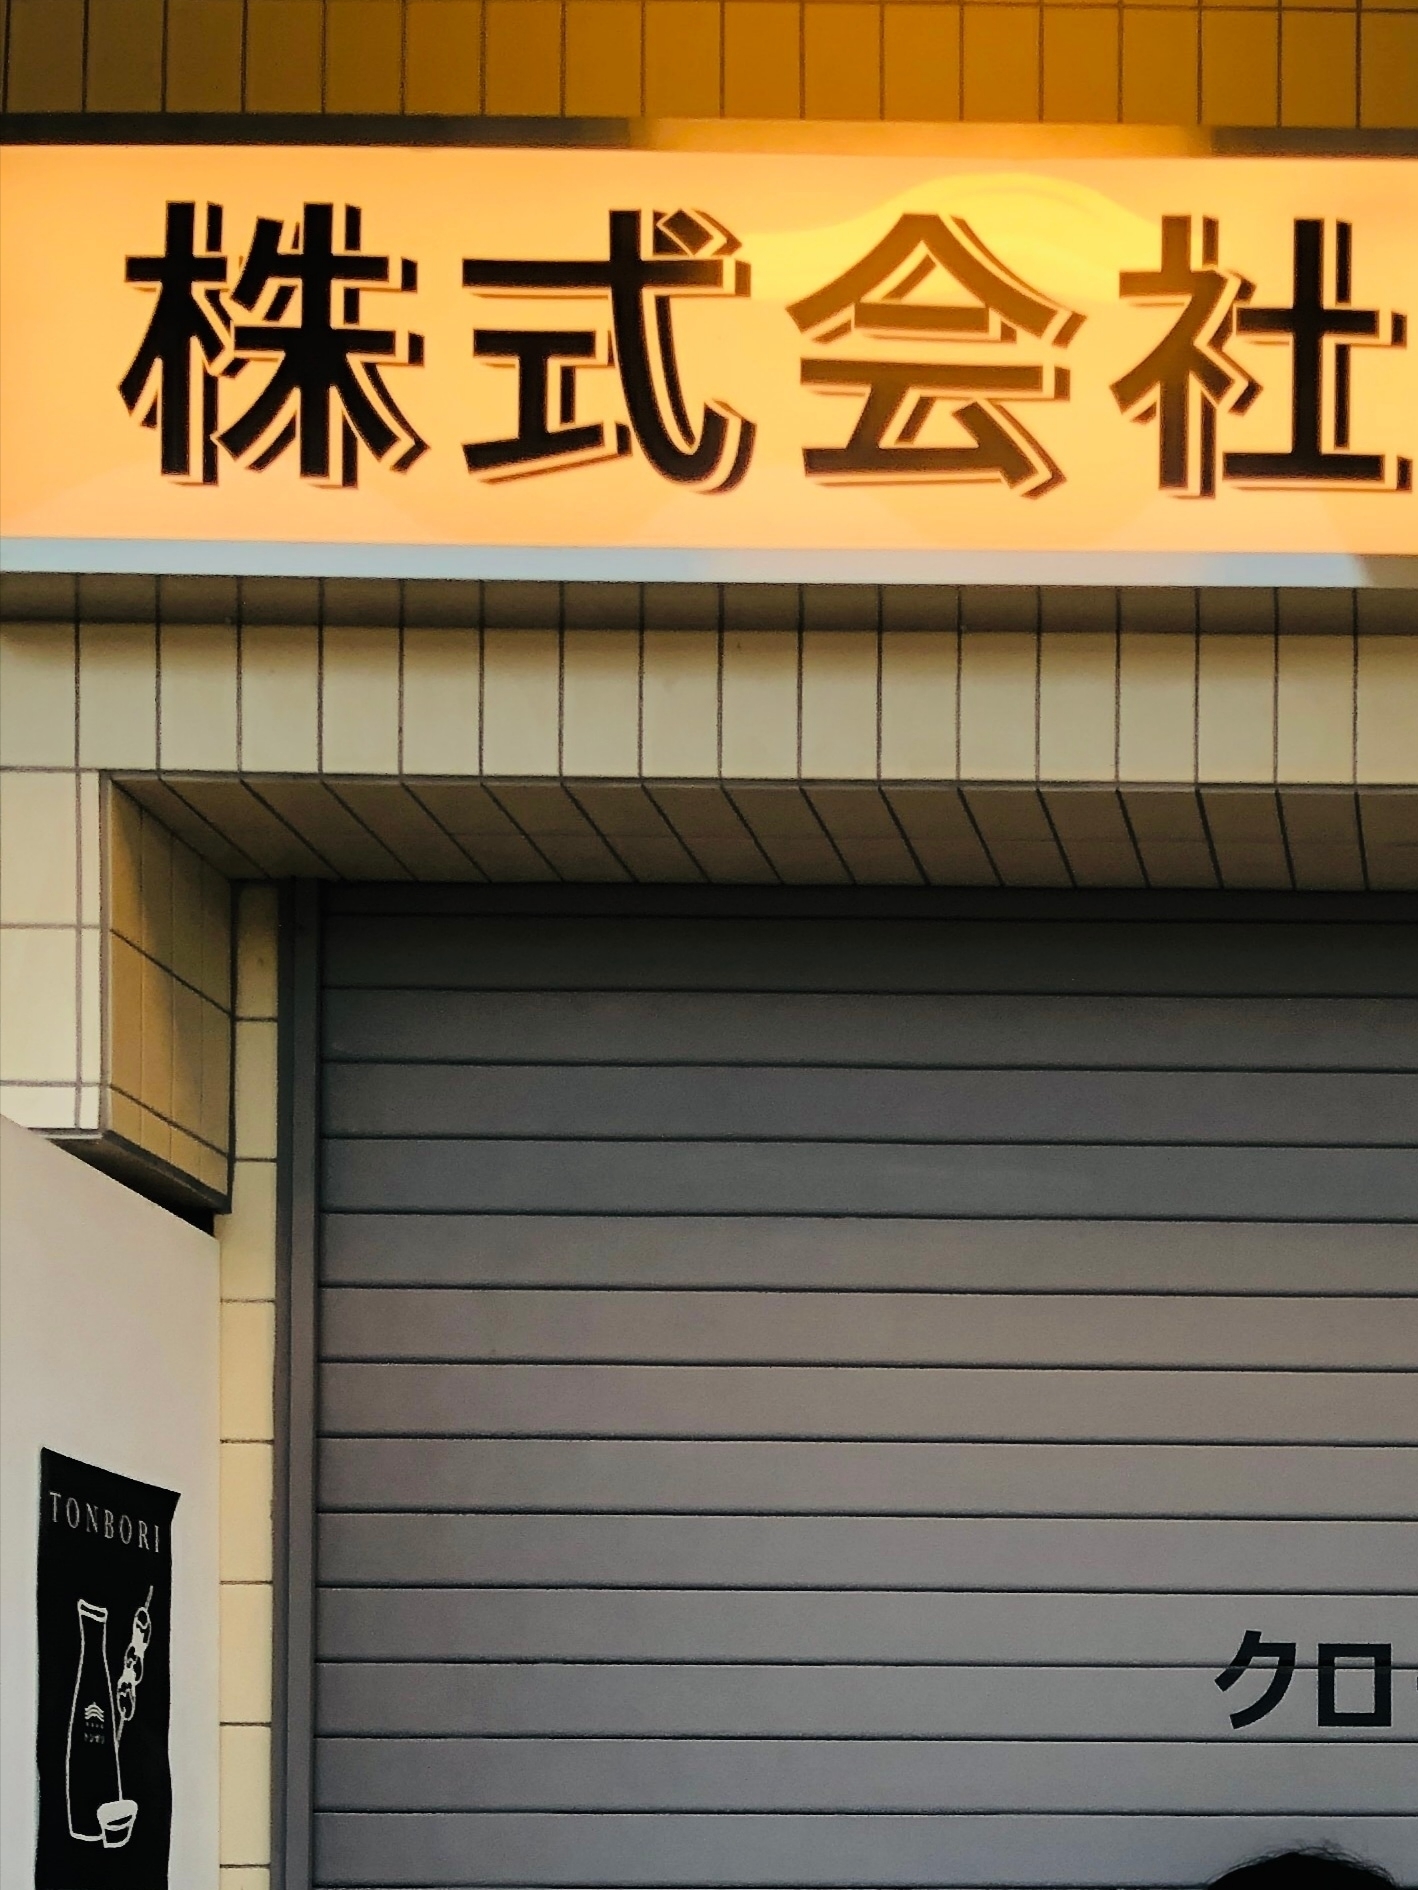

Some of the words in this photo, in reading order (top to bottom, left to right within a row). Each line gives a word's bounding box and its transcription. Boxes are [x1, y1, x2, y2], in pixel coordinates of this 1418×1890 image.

[117, 200, 1413, 498] 株式会社
[49, 1491, 160, 1553] TONBORI
